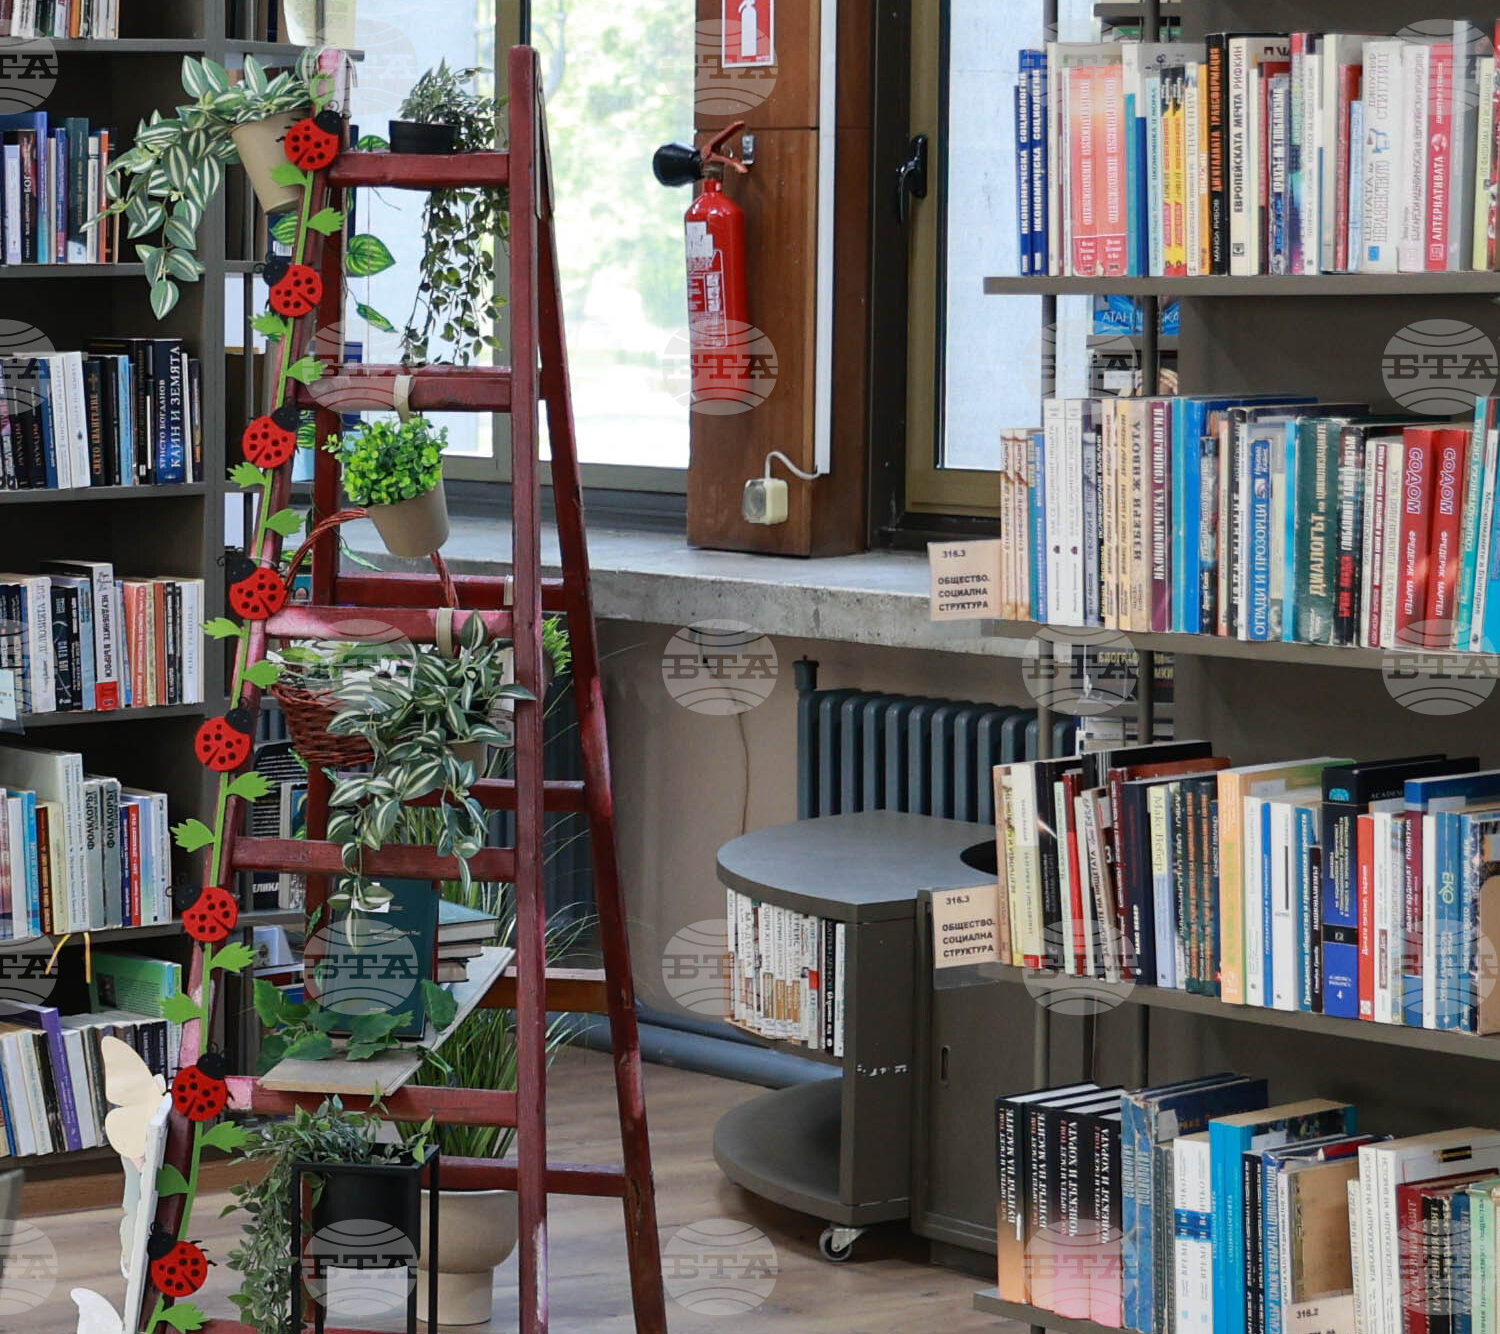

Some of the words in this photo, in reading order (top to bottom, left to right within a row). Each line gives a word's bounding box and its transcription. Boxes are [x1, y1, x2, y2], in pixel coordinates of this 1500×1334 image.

[1232, 45, 1244, 90] РИФКИН
[1232, 93, 1244, 128] МЕЧТА
[1233, 132, 1245, 213] ЕВРОПЕЙСКАТА
[169, 345, 182, 405] ЗЕМЯТА
[169, 426, 182, 468] КАИН
[1131, 420, 1143, 491] ЖИВОТА
[1407, 447, 1423, 515] СОДОМ
[1131, 495, 1144, 561] ИЗБЕРИ
[1251, 503, 1267, 572] ПРОЗОРЦИ
[941, 549, 966, 559] 316.3
[1308, 514, 1328, 597] ДИАЛОГЪТ
[938, 587, 988, 599] СОЦИАЛНА
[938, 601, 989, 612] СТРУКТУРА
[1251, 588, 1268, 636] ОГРАДИ
[85, 791, 95, 851] ФОЛКЛОРЪТ
[106, 789, 116, 849] ФОЛКЛОРЪТ
[945, 895, 970, 905] 316.3
[942, 932, 993, 945] СОЦИАЛНА
[943, 944, 994, 958] СТРУКТУРА
[1004, 1108, 1016, 1156] МАСИТЕ
